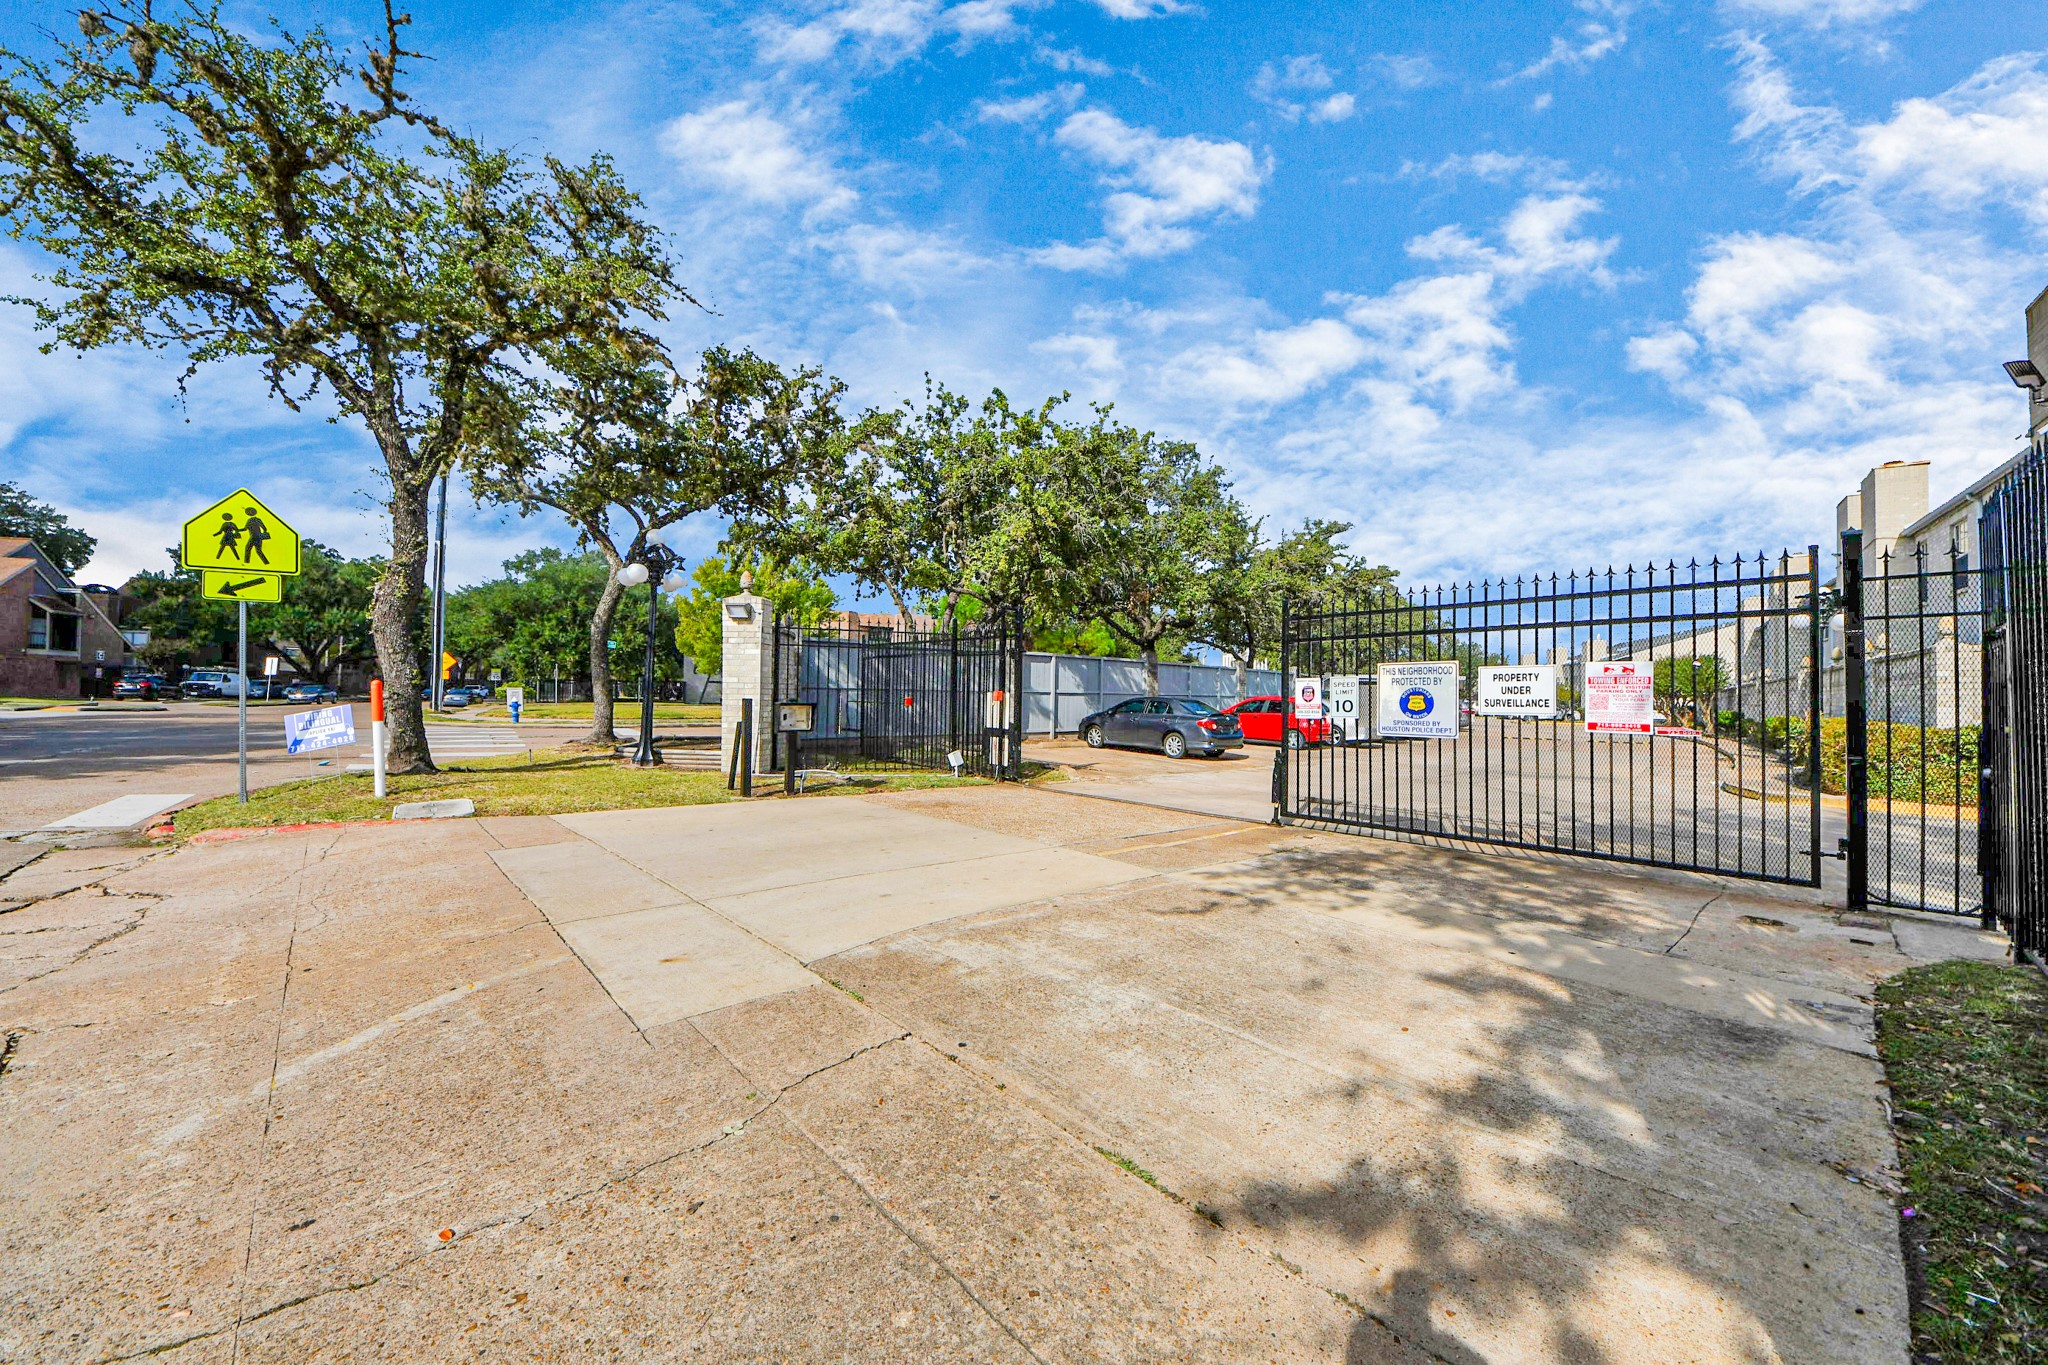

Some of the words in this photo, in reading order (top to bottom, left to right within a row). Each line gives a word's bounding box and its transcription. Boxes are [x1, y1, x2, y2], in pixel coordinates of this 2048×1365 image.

[1382, 667, 1396, 676] THIS
[1398, 666, 1454, 675] NEIGHBORHOOD
[1392, 677, 1432, 686] PROTECTED
[1434, 677, 1442, 686] BY
[1492, 673, 1540, 682] PROPERTY
[1501, 686, 1531, 694] UNDER
[1336, 700, 1353, 712] 10
[1484, 699, 1550, 708] SURVEILLANCE
[304, 710, 333, 721] HIRING
[298, 716, 341, 730] BILINGUAL
[291, 736, 354, 752] 713-424-4020
